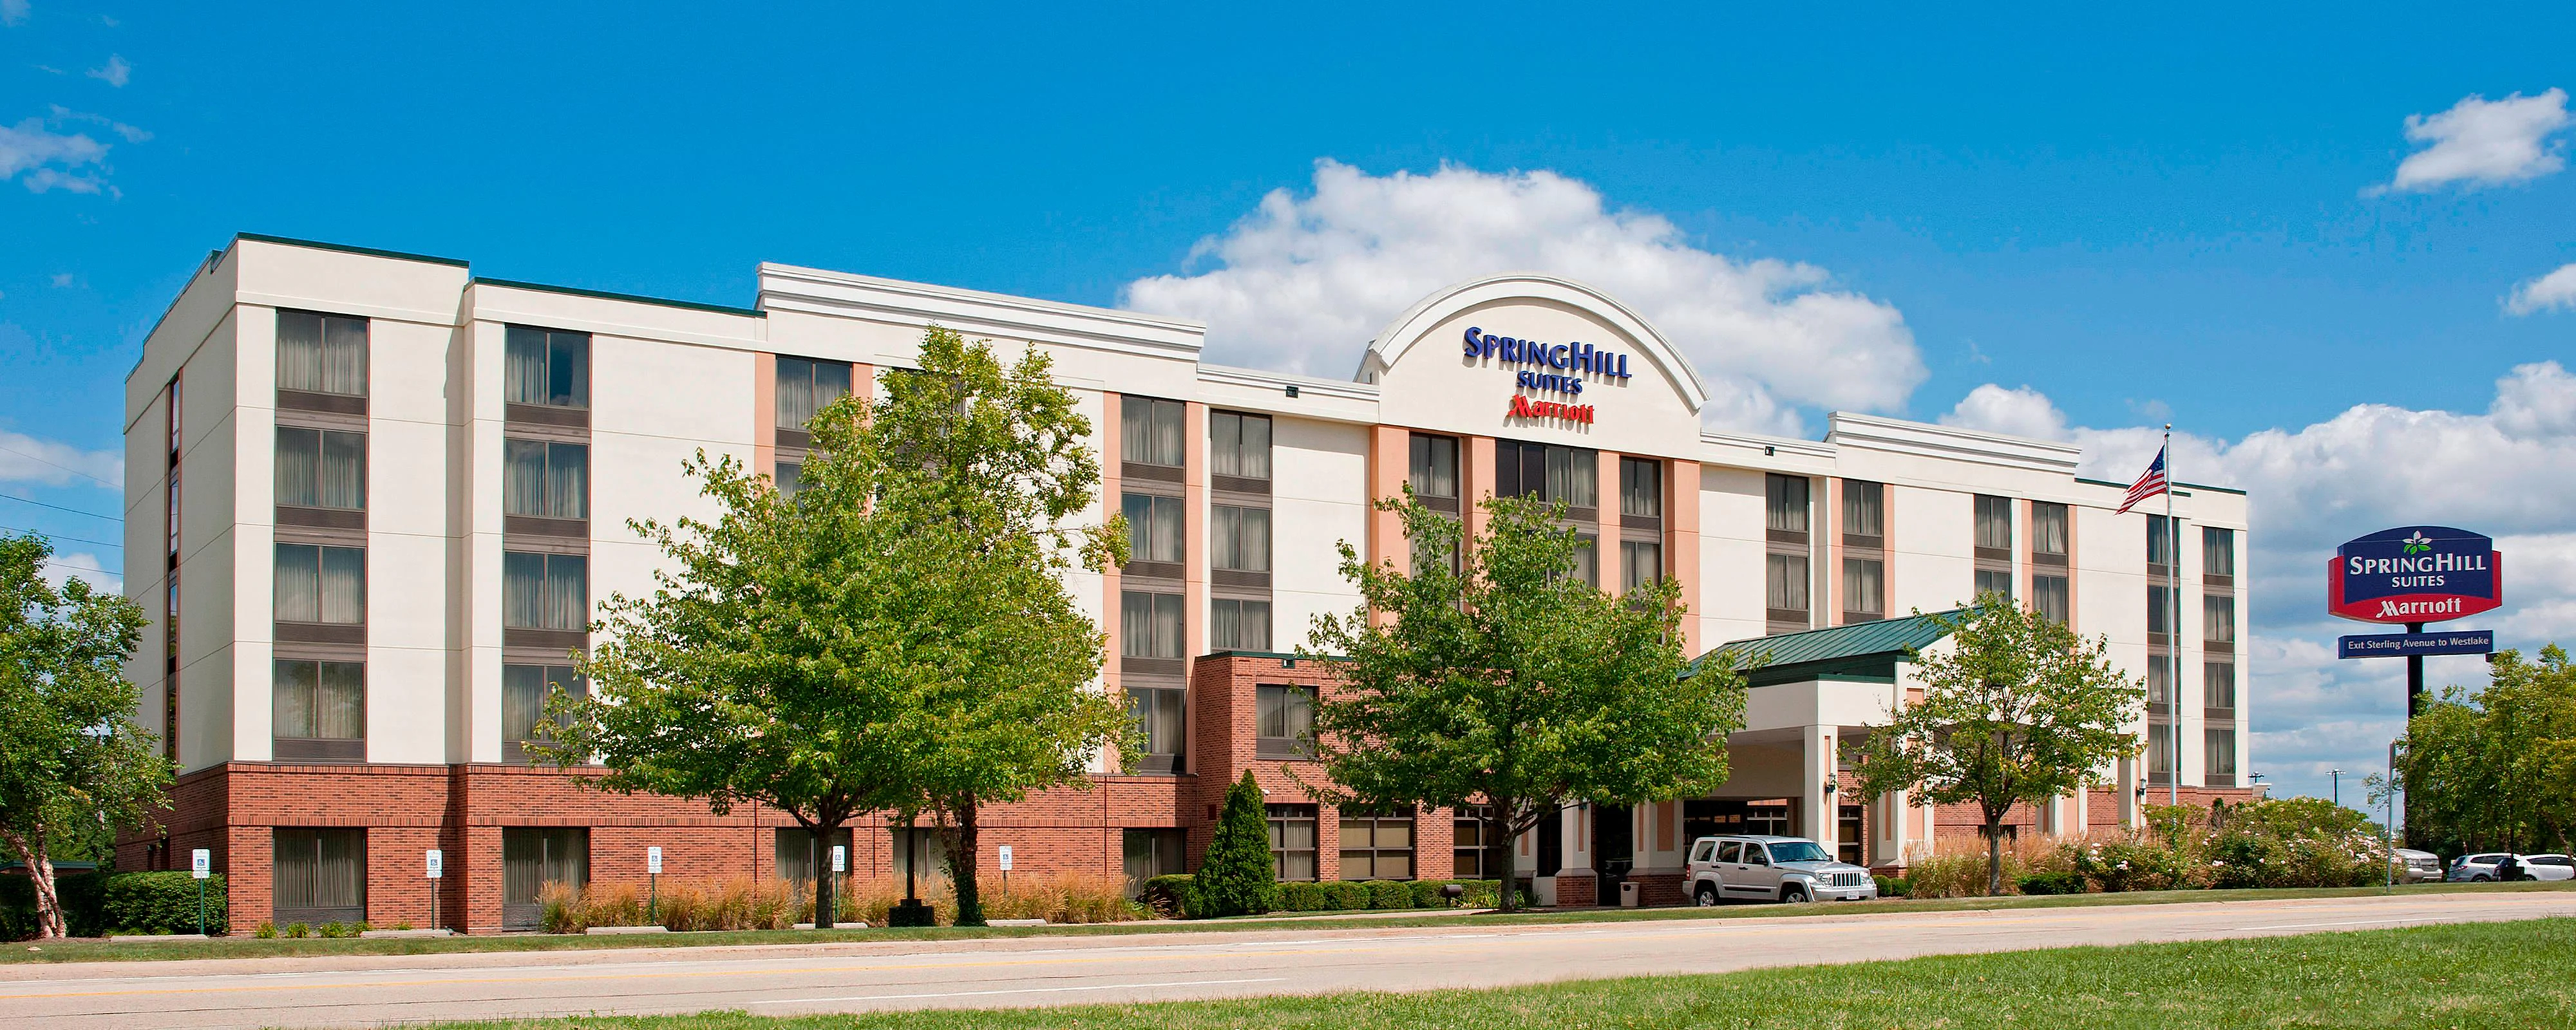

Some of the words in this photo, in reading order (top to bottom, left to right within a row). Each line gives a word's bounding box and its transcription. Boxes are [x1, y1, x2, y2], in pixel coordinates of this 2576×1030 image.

[1464, 326, 1632, 379] SPRINGHILL
[1517, 370, 1583, 395] SUITES
[1508, 394, 1595, 424] Marriott
[2350, 553, 2486, 575] SPRINGHILL
[2392, 576, 2445, 587] SUITES
[2376, 598, 2461, 618] Marriott
[2348, 641, 2364, 650] Exit
[2367, 640, 2401, 650] Sterling
[2403, 639, 2435, 648] Avenue
[2449, 637, 2489, 646] Westlake
